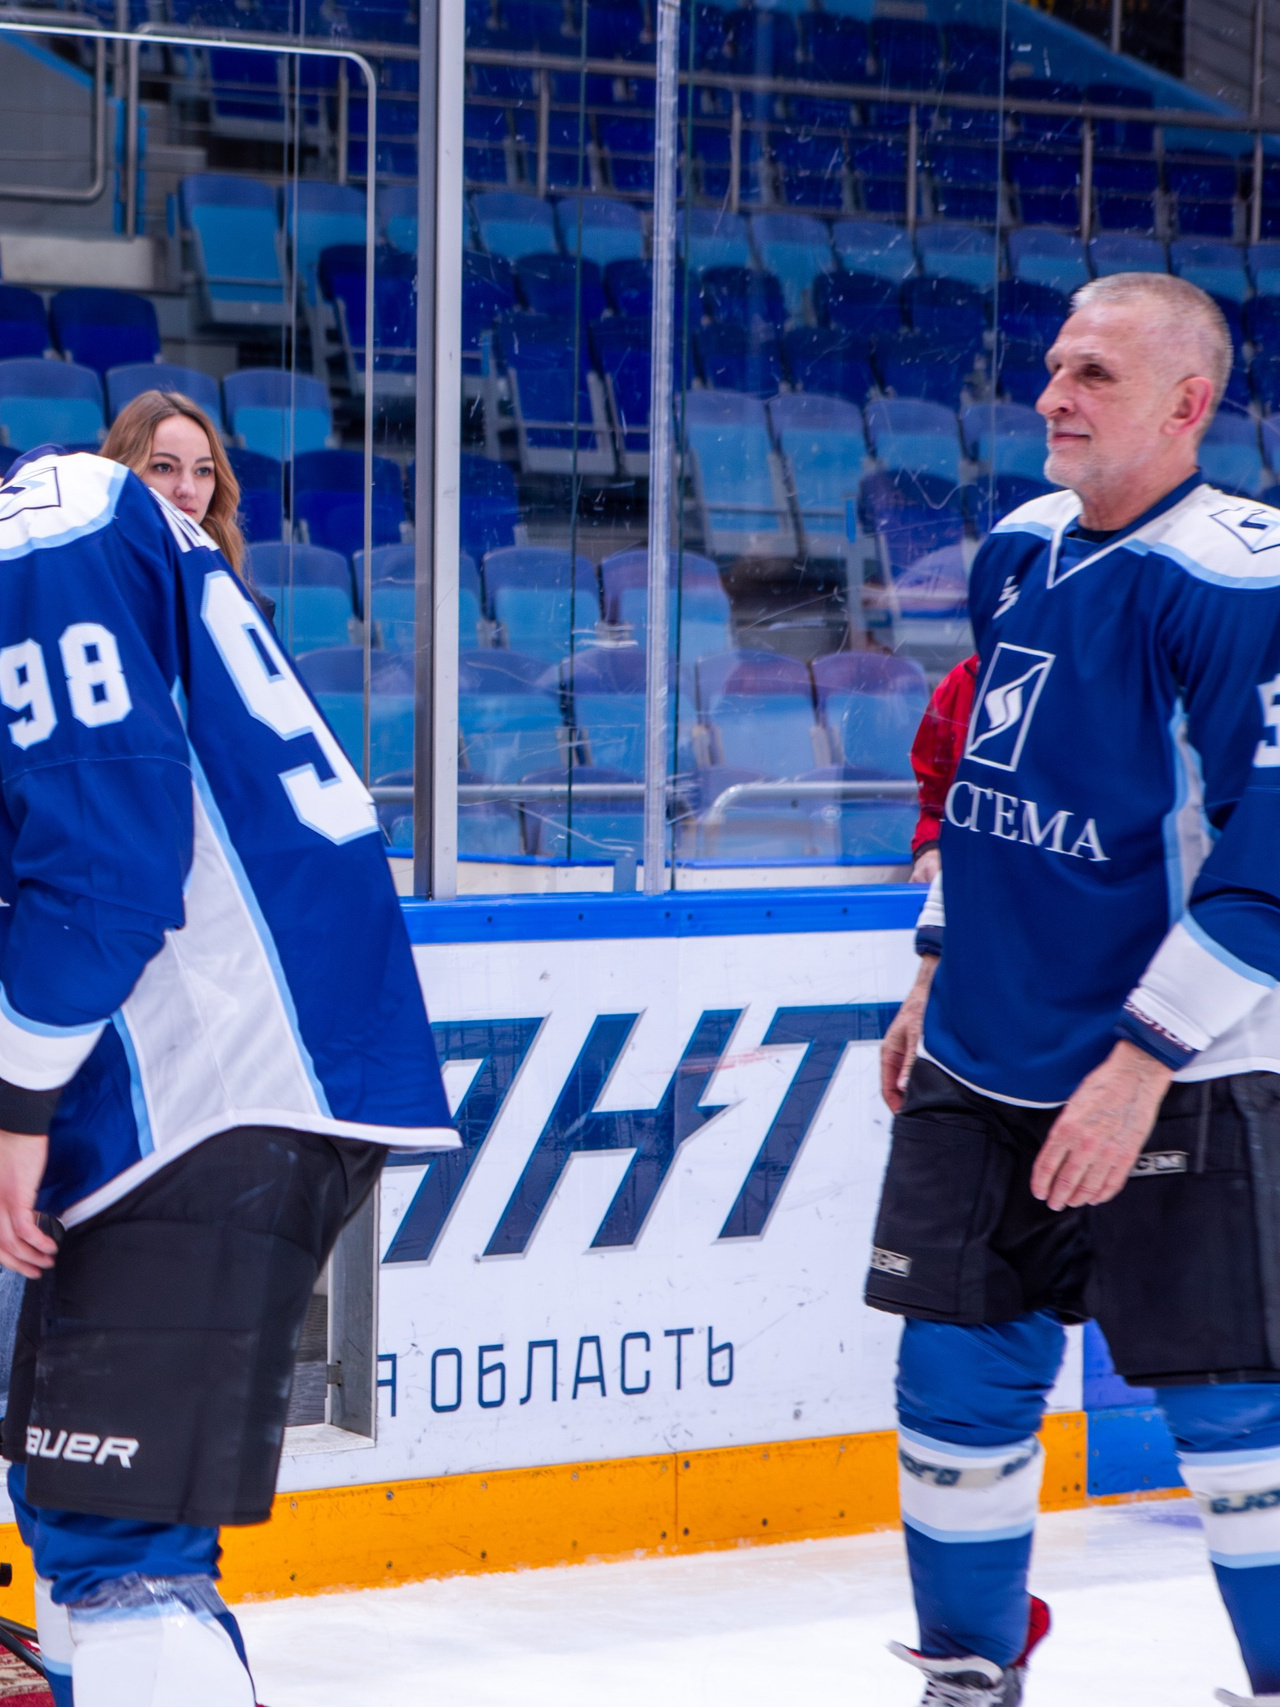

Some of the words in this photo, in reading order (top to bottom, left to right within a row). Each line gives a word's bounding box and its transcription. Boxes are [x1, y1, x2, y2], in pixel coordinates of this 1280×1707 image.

[940, 780, 1111, 863] СТЕМА
[430, 1325, 734, 1414] ОБЛАСТЬ
[26, 1425, 140, 1469] AUER
